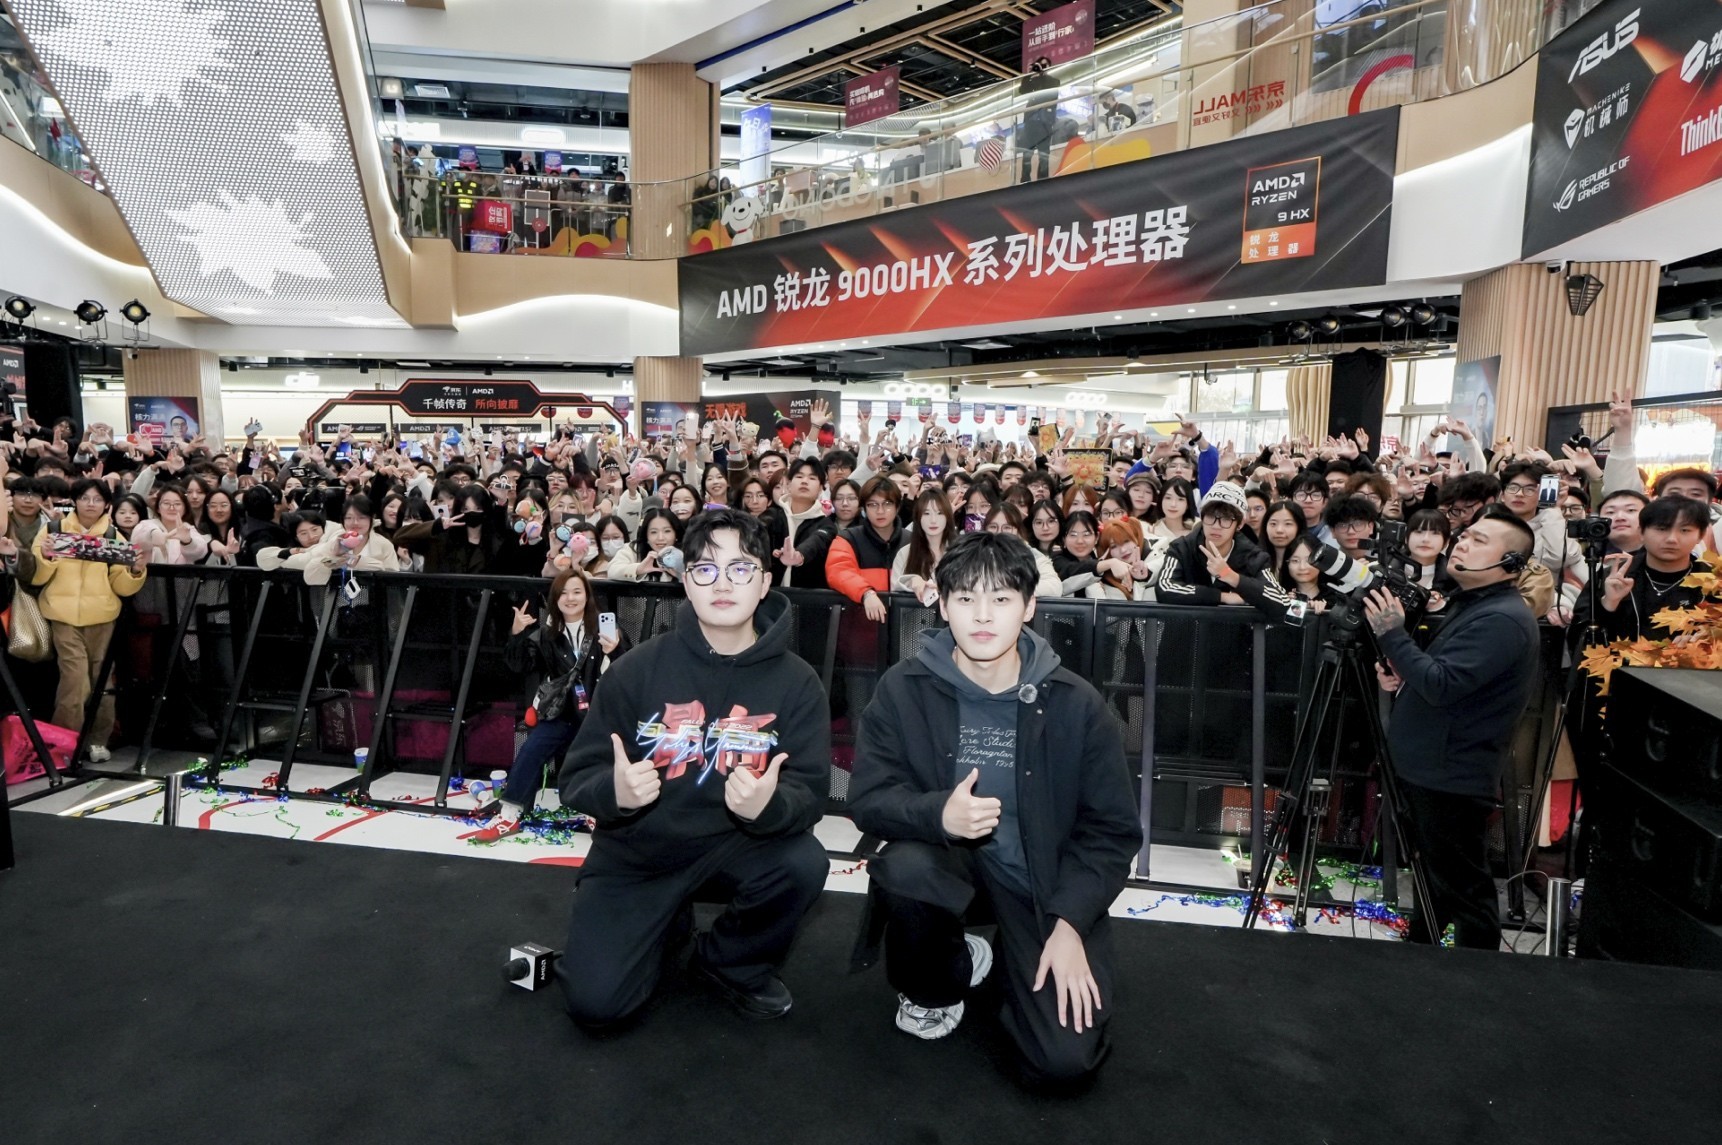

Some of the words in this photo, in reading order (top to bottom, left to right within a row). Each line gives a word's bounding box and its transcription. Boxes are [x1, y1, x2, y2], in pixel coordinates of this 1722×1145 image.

[1568, 8, 1641, 84] ASUS
[1710, 29, 1722, 55] 机
[1706, 53, 1722, 70] ME
[1587, 82, 1631, 116] MACHENIKE
[1584, 94, 1629, 138] 机械师
[1579, 162, 1617, 189] REPUBLIC
[1619, 155, 1631, 170] OF
[1252, 176, 1291, 194] AMD
[1578, 178, 1610, 202] GAMERS
[1251, 190, 1298, 206] RYZEN
[1278, 212, 1287, 222] 9
[1290, 208, 1310, 220] HX
[1249, 242, 1299, 259] 处理器
[716, 285, 768, 319] AMD
[773, 267, 830, 313] 锐龙
[837, 252, 955, 301] 9000HX
[963, 204, 1190, 287] 系列处理器
[422, 398, 467, 410] 千帧传奇
[475, 400, 519, 410] 所向披靡
[791, 399, 806, 407] AMD
[983, 735, 1016, 748] Studi
